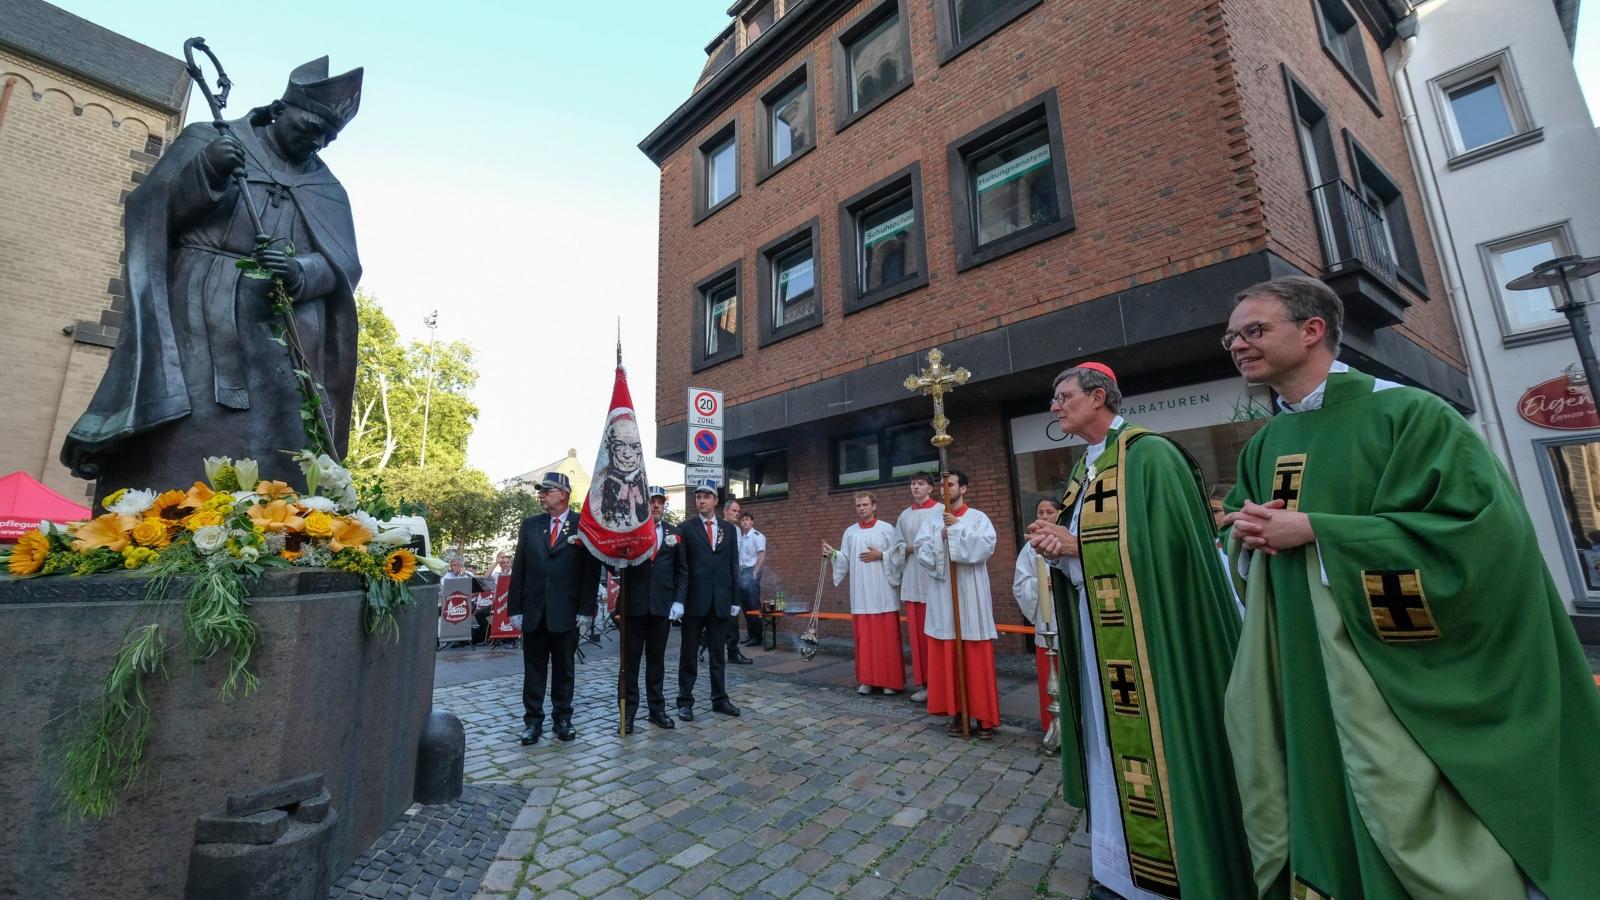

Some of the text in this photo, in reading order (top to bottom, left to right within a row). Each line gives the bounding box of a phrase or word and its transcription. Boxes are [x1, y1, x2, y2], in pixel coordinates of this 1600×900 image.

[978, 149, 1049, 186] Haltungsanalyse
[866, 214, 914, 240] Schuhtechn
[700, 398, 713, 410] 20
[1117, 393, 1211, 417] PARATUREN
[697, 416, 715, 425] ZONE
[696, 455, 715, 463] ZONE
